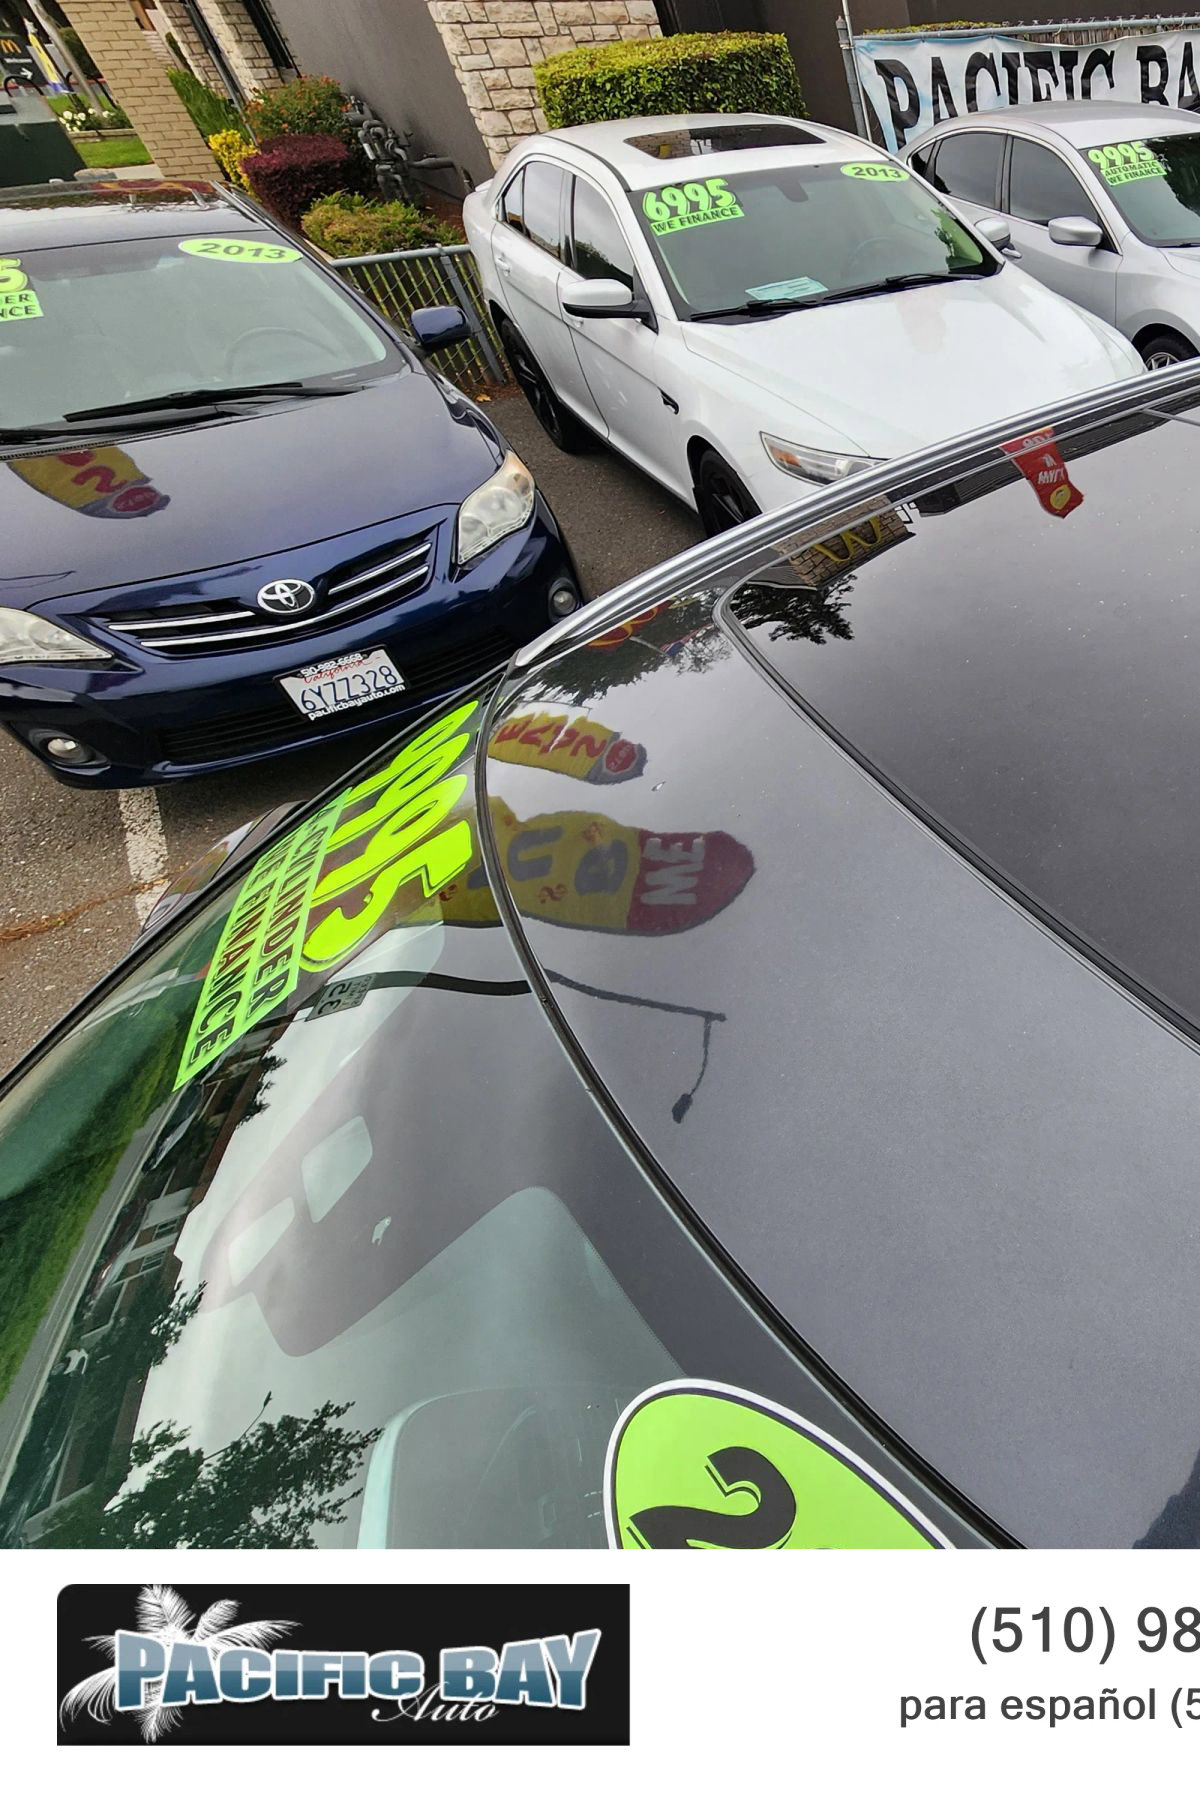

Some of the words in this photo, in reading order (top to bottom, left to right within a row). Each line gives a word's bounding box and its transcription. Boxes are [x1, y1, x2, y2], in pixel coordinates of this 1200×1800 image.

[1087, 141, 1155, 170] 9995
[1104, 162, 1158, 177] AUTOMATIC
[852, 165, 901, 178] 2013
[1108, 175, 1122, 184] WE
[1125, 167, 1161, 182] FINANCE
[642, 178, 736, 222] 6995
[653, 220, 676, 233] WE
[679, 206, 739, 227] FINANCE
[196, 242, 286, 259] 2013
[301, 665, 397, 711] 6YZZ328
[308, 684, 406, 721] pacificbayauto.com
[190, 881, 275, 1065] FINANCE
